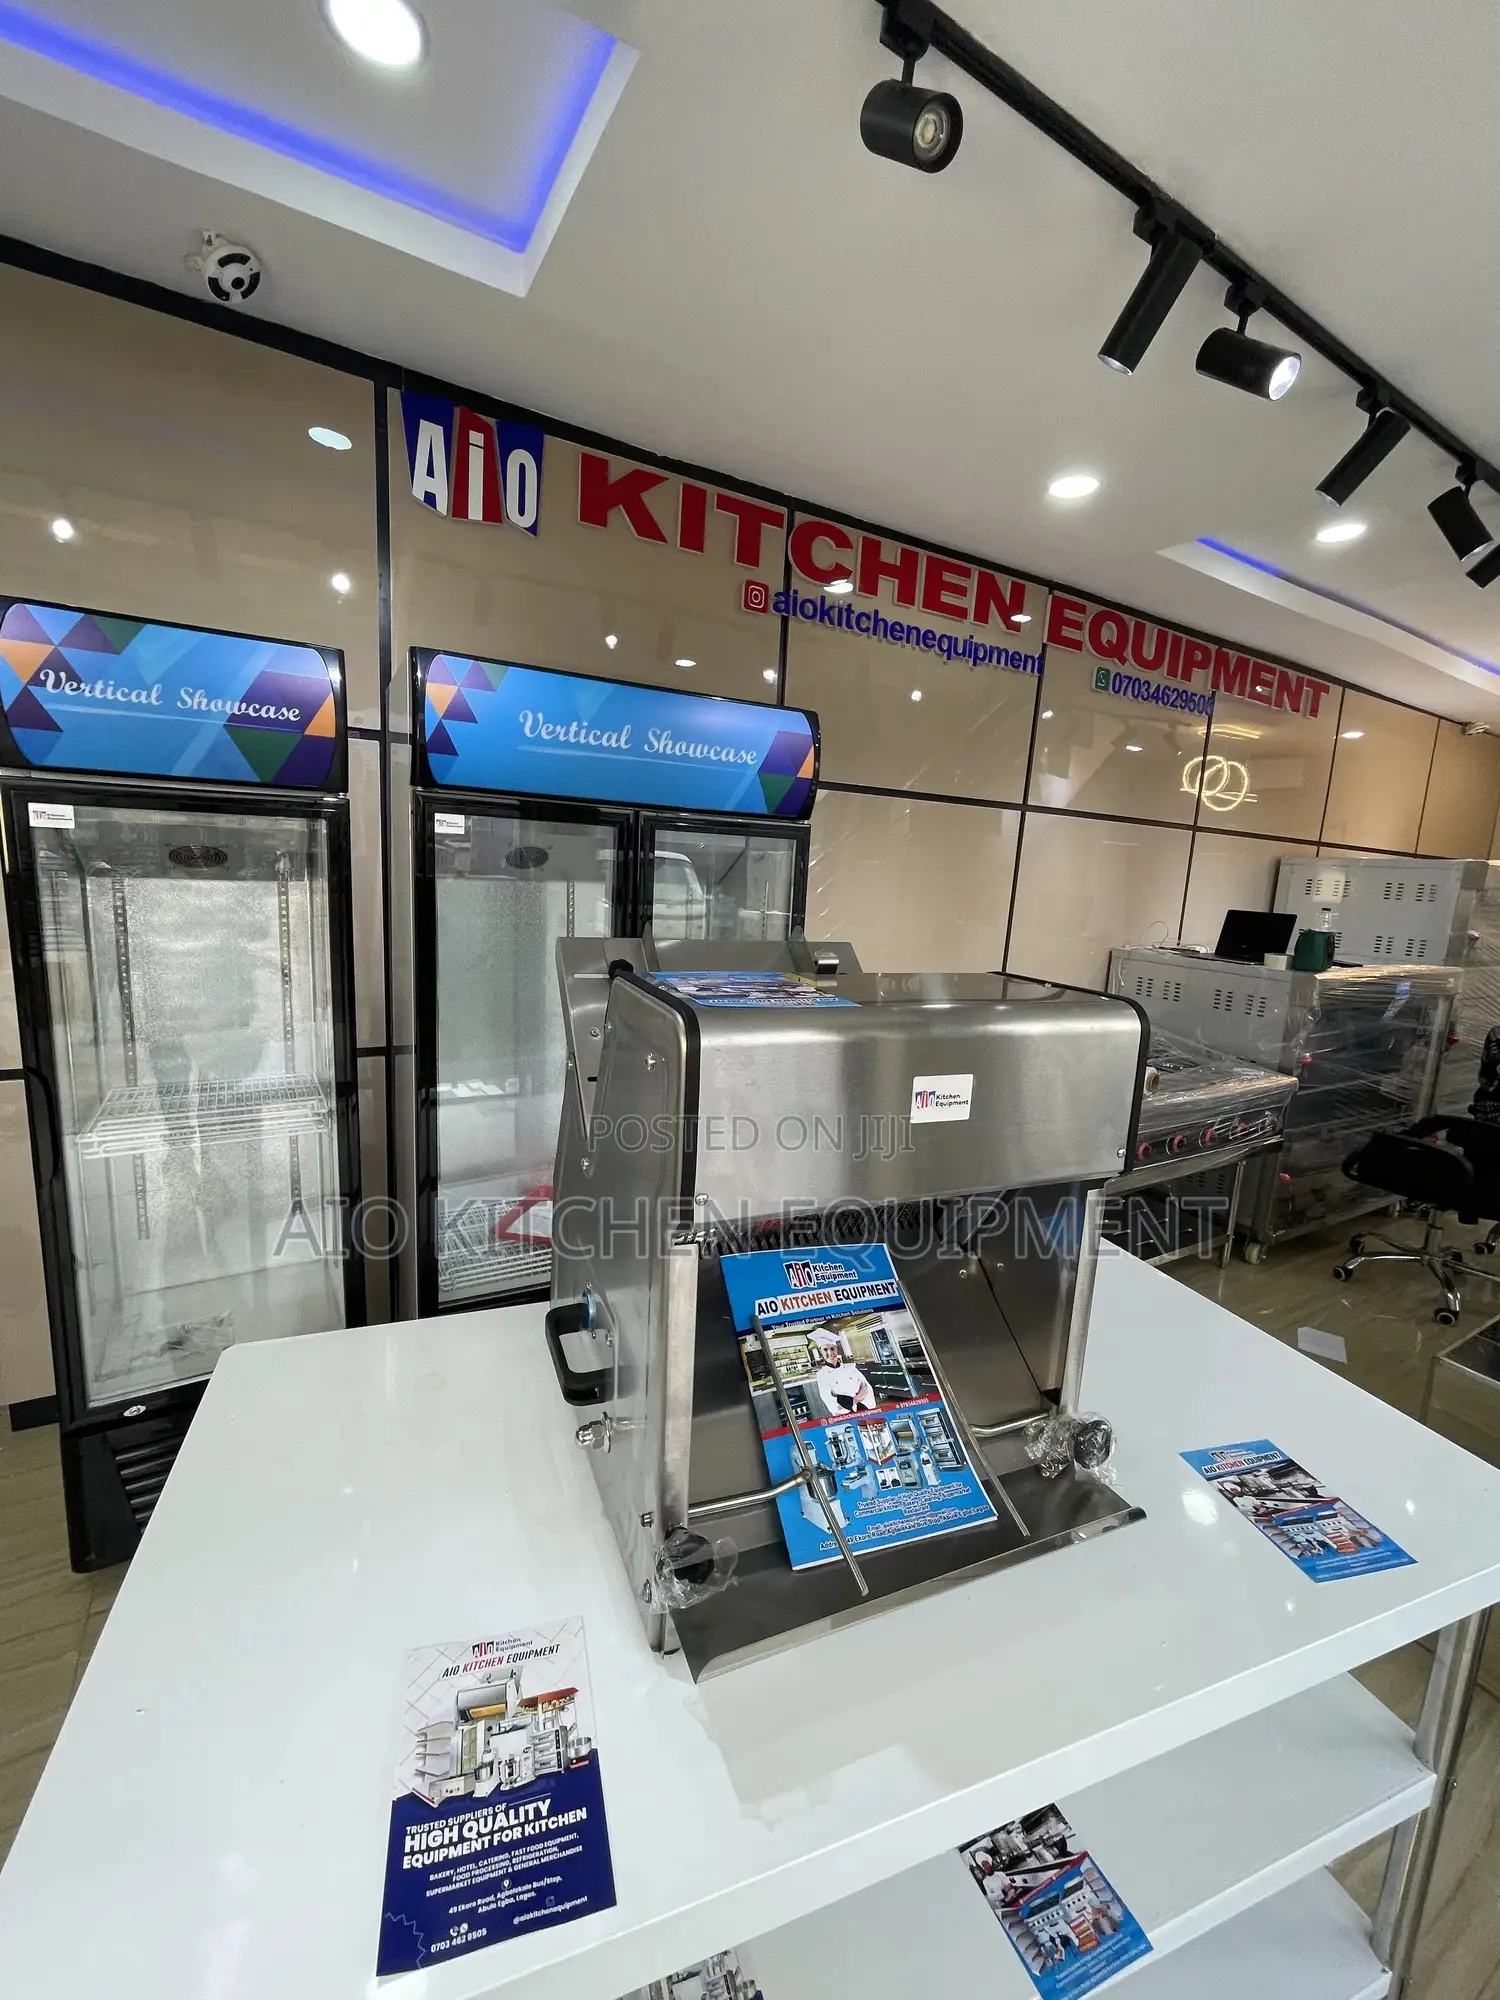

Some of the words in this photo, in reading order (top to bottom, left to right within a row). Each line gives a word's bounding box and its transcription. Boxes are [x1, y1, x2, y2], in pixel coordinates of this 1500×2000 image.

[577, 452, 1026, 633] KITCHEN
[1046, 593, 1331, 718] EQUIPMENT
[772, 588, 1044, 676] aiokitchenequipment
[40, 668, 163, 706] Vertical
[176, 686, 301, 722] Showcase
[518, 710, 632, 750] Vertical
[643, 727, 758, 765] Showcase
[935, 1099, 969, 1107] Equipment
[813, 1264, 843, 1272] Kitchen
[815, 1271, 857, 1281] Equipment
[758, 1300, 778, 1315] AIO
[781, 1292, 832, 1310] KITCHEN
[835, 1282, 896, 1301] EQUIPMENT
[495, 1638, 521, 1646] Kitchen
[495, 1640, 533, 1652] Equipment
[442, 1665, 460, 1678] AIO
[462, 1656, 504, 1673] KITCHEN
[506, 1644, 560, 1663] EQUIPMENT
[404, 1825, 458, 1853] HIGH
[462, 1799, 551, 1839] QUALITY
[406, 1819, 446, 1835] TRUSTED
[448, 1807, 493, 1827] SUPPLIERS
[495, 1803, 507, 1813] OF
[403, 1837, 491, 1869] EQUIPMENT
[493, 1825, 522, 1846] FOR
[525, 1807, 587, 1836] KITCHEN
[511, 1848, 526, 1857] FAST
[527, 1844, 543, 1853] FOOD
[426, 1880, 471, 1897] SUPERMARKET
[472, 1869, 506, 1884] EQUIPMENT
[514, 1859, 540, 1871] GENERAL
[541, 1845, 583, 1864] MERCHANDISE
[453, 1871, 470, 1882] FOOD
[431, 1939, 450, 1953] 0703
